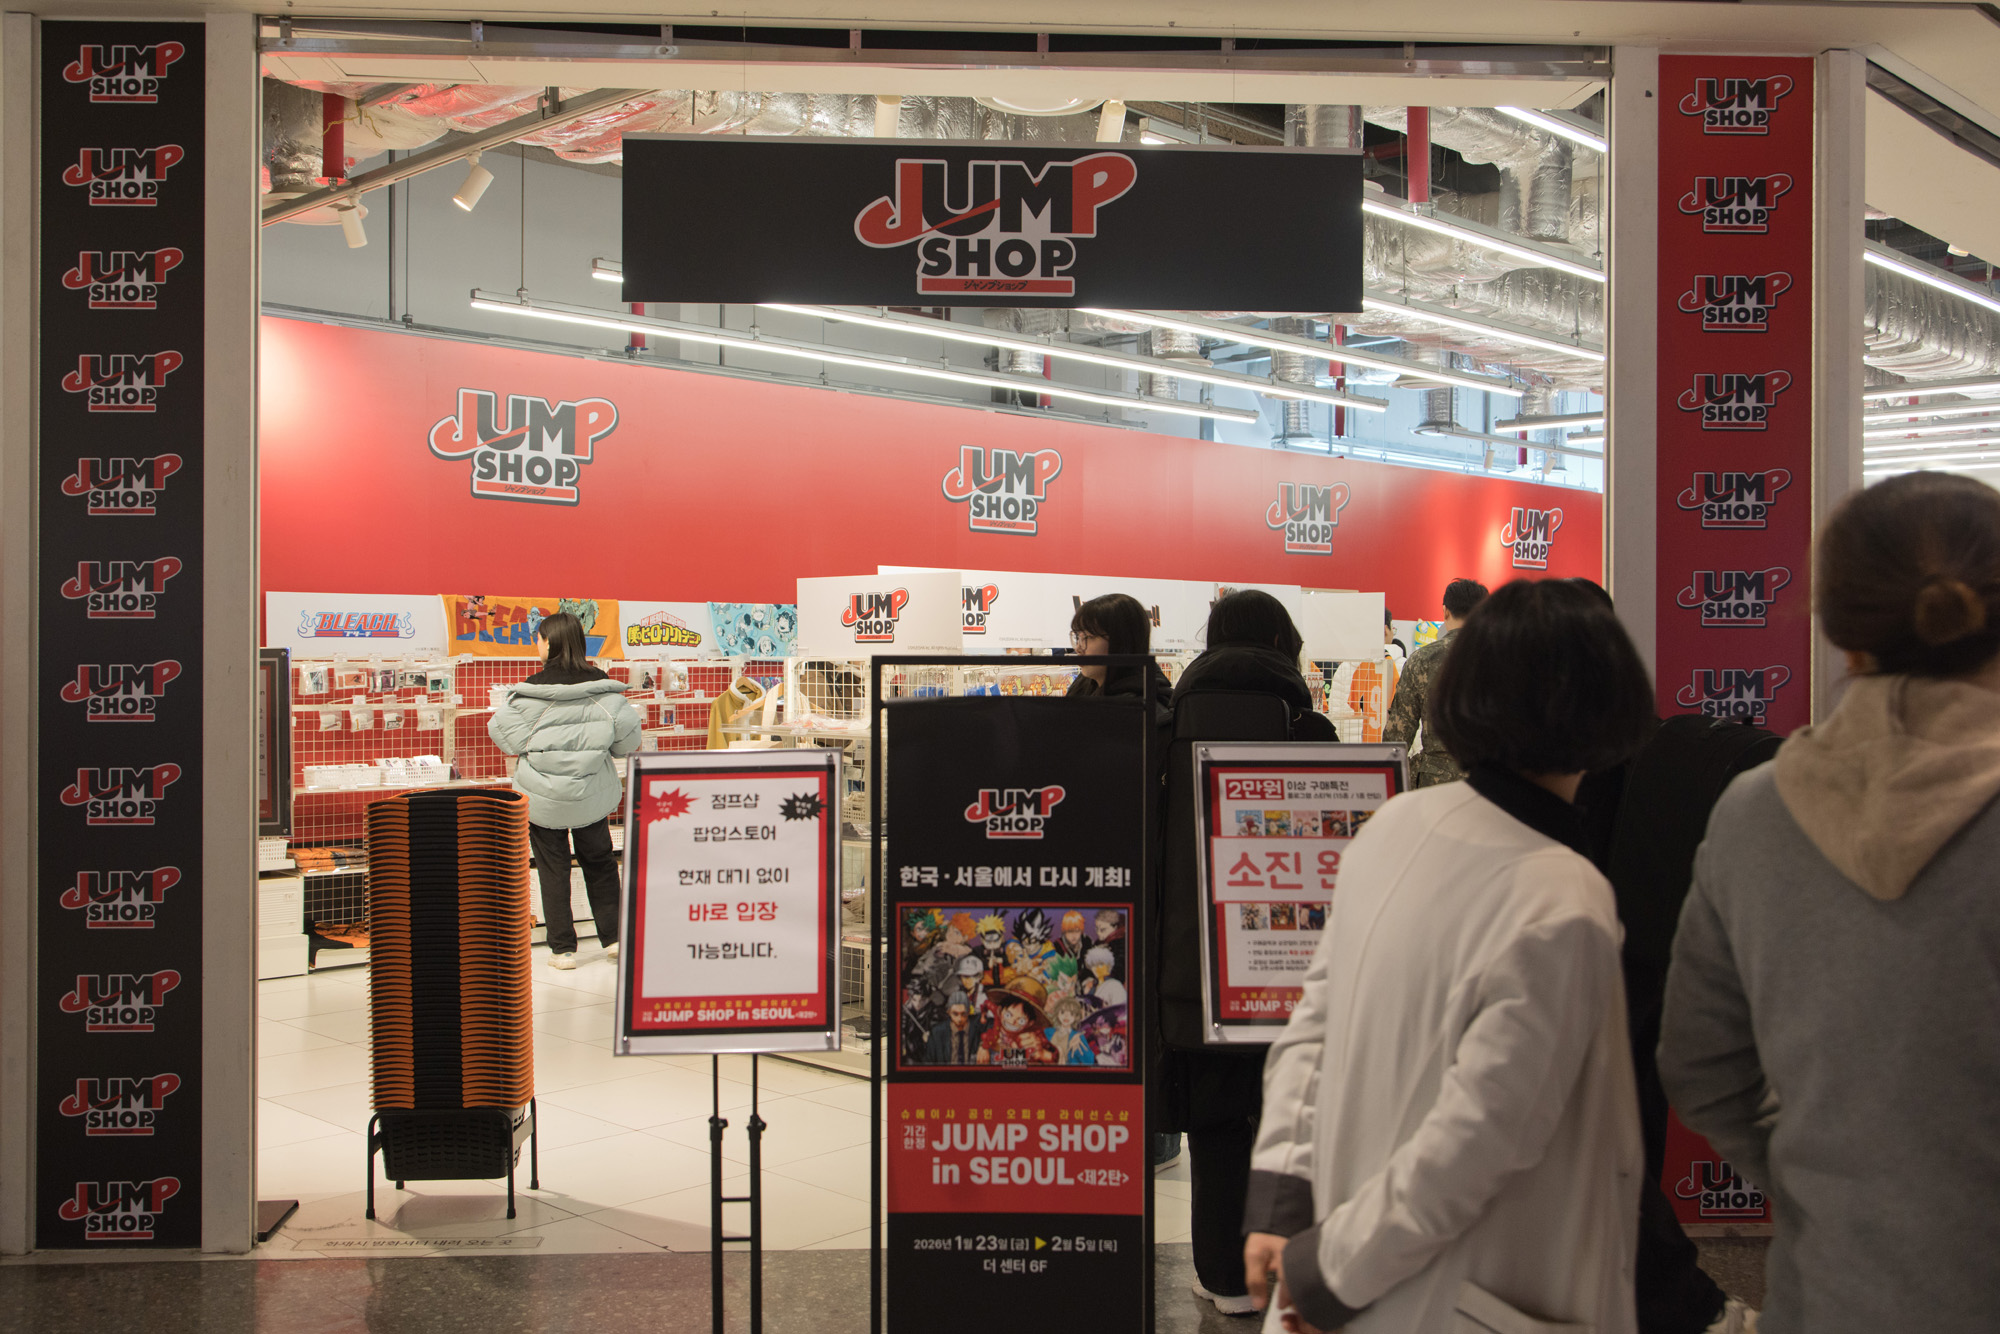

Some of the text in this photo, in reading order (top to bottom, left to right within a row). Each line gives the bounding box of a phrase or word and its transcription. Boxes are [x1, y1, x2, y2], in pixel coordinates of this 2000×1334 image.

[63, 42, 184, 82] JUMP
[90, 78, 158, 96] SHOP
[1678, 75, 1793, 115] JUMP
[1705, 110, 1767, 126] SHOP
[63, 145, 184, 185] JUMP
[90, 181, 157, 199] SHOP
[854, 152, 1137, 248] JUMP
[1678, 173, 1793, 213] JUMP
[1705, 208, 1767, 224] SHOP
[919, 237, 1074, 278] SHOP
[62, 248, 184, 288] JUMP
[90, 284, 157, 302] SHOP
[963, 280, 1029, 292] ジャンプショップ
[1678, 272, 1792, 312] JUMP
[1704, 307, 1766, 323] SHOP
[62, 352, 183, 392] JUMP
[89, 388, 156, 406] SHOP
[1677, 370, 1792, 410] JUMP
[1704, 405, 1766, 421] SHOP
[428, 388, 619, 460] JUMP
[61, 455, 183, 495] JUMP
[475, 450, 577, 487] SHOP
[942, 445, 1062, 502] JUMP
[1677, 469, 1791, 509] JUMP
[89, 491, 156, 509] SHOP
[971, 493, 1036, 521] SHOP
[1266, 482, 1350, 530] JUMP
[1703, 504, 1765, 520] SHOP
[1286, 522, 1332, 544] SHOP
[1500, 507, 1563, 547] JUMP
[1513, 541, 1547, 561] SHOP
[61, 558, 183, 598] JUMP
[1676, 567, 1791, 607] JUMP
[89, 594, 156, 612] SHOP
[841, 588, 909, 627] JUMP
[1703, 602, 1765, 618] SHOP
[315, 612, 399, 631] BLEACH
[856, 620, 894, 635] SHOP
[61, 661, 182, 701] JUMP
[1676, 665, 1791, 705] JUMP
[88, 697, 155, 715] SHOP
[1703, 700, 1765, 717] SHOP
[60, 764, 182, 804] JUMP
[1228, 780, 1284, 800] 2만원
[1287, 780, 1306, 791] 이상
[88, 800, 155, 818] SHOP
[711, 793, 760, 809] 점프샵
[965, 785, 1066, 823] JUMP
[693, 825, 777, 843] 팝업스토어
[988, 817, 1044, 832] SHOP
[678, 867, 790, 886] 현재 대기 없이
[1040, 866, 1078, 888] 다시
[1085, 866, 1131, 888] 개최!
[1226, 851, 1304, 890] 소진
[60, 868, 181, 908] JUMP
[87, 904, 154, 922] SHOP
[688, 901, 778, 922] 바로 입장
[687, 943, 778, 960] 가능합니다.
[60, 971, 181, 1011] JUMP
[87, 1007, 154, 1025] SHOP
[654, 1010, 694, 1023] JUMP
[697, 1009, 734, 1022] SHOP
[737, 1008, 749, 1021] in
[752, 1007, 795, 1021] SEOUL
[1241, 1000, 1281, 1012] JUMP
[59, 1074, 181, 1114] JUMP
[87, 1110, 154, 1128] SHOP
[903, 1124, 926, 1137] 기간
[932, 1123, 1129, 1152] JUMP SHOP
[932, 1157, 960, 1184] in
[970, 1157, 1075, 1185] SEOUL
[59, 1177, 180, 1217] JUMP
[1701, 1192, 1763, 1208] SHOP
[86, 1213, 153, 1231] SHOP
[976, 1235, 1008, 1251] 23일
[1051, 1236, 1072, 1251] 2월
[1075, 1236, 1096, 1252] 5일
[983, 1258, 1048, 1274] 더 센터 6F
